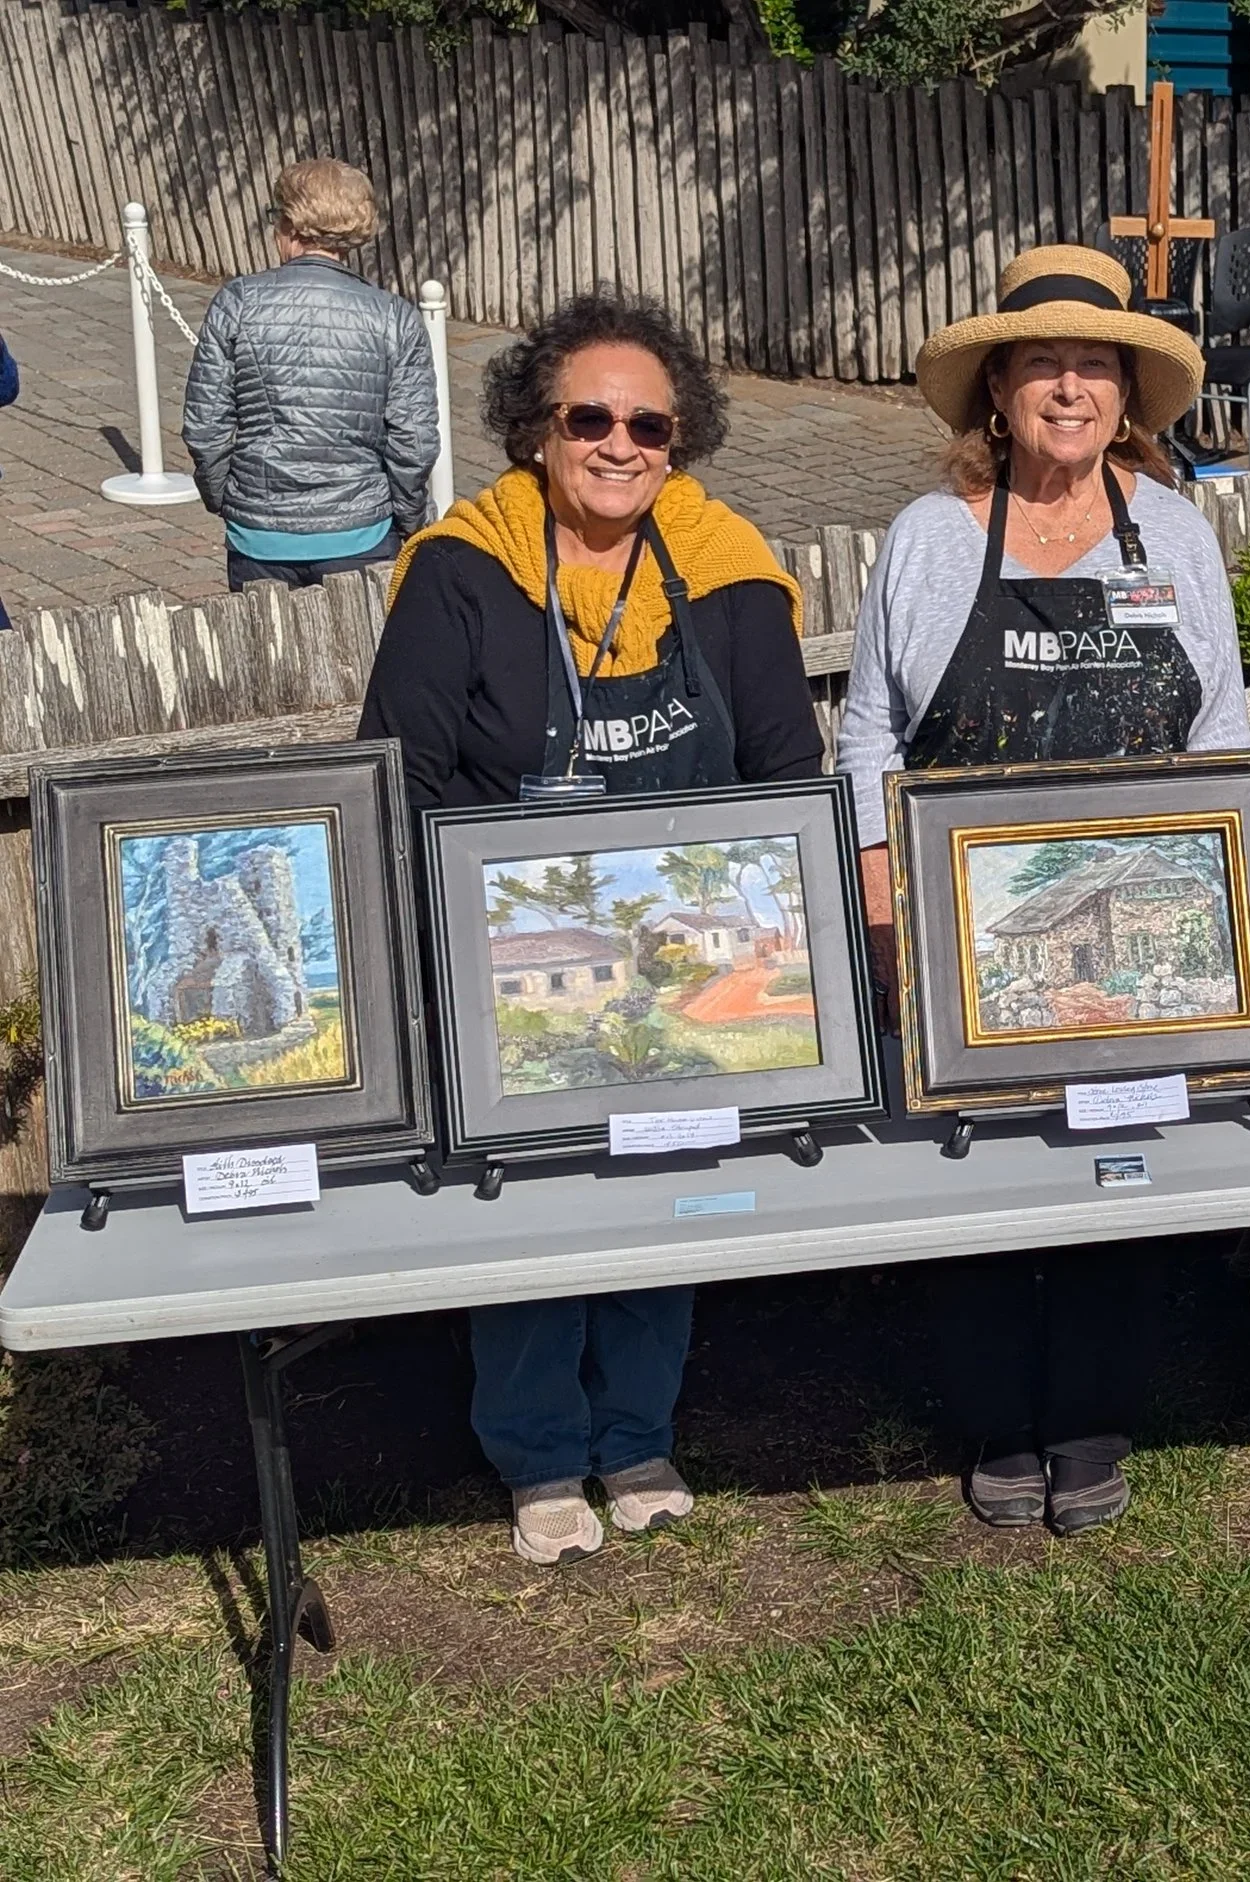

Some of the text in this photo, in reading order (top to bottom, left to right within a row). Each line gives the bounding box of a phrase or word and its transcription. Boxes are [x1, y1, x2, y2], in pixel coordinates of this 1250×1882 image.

[1004, 629, 1142, 661] MBPAPA
[1040, 663, 1055, 672] Bay
[1106, 659, 1143, 669] Association
